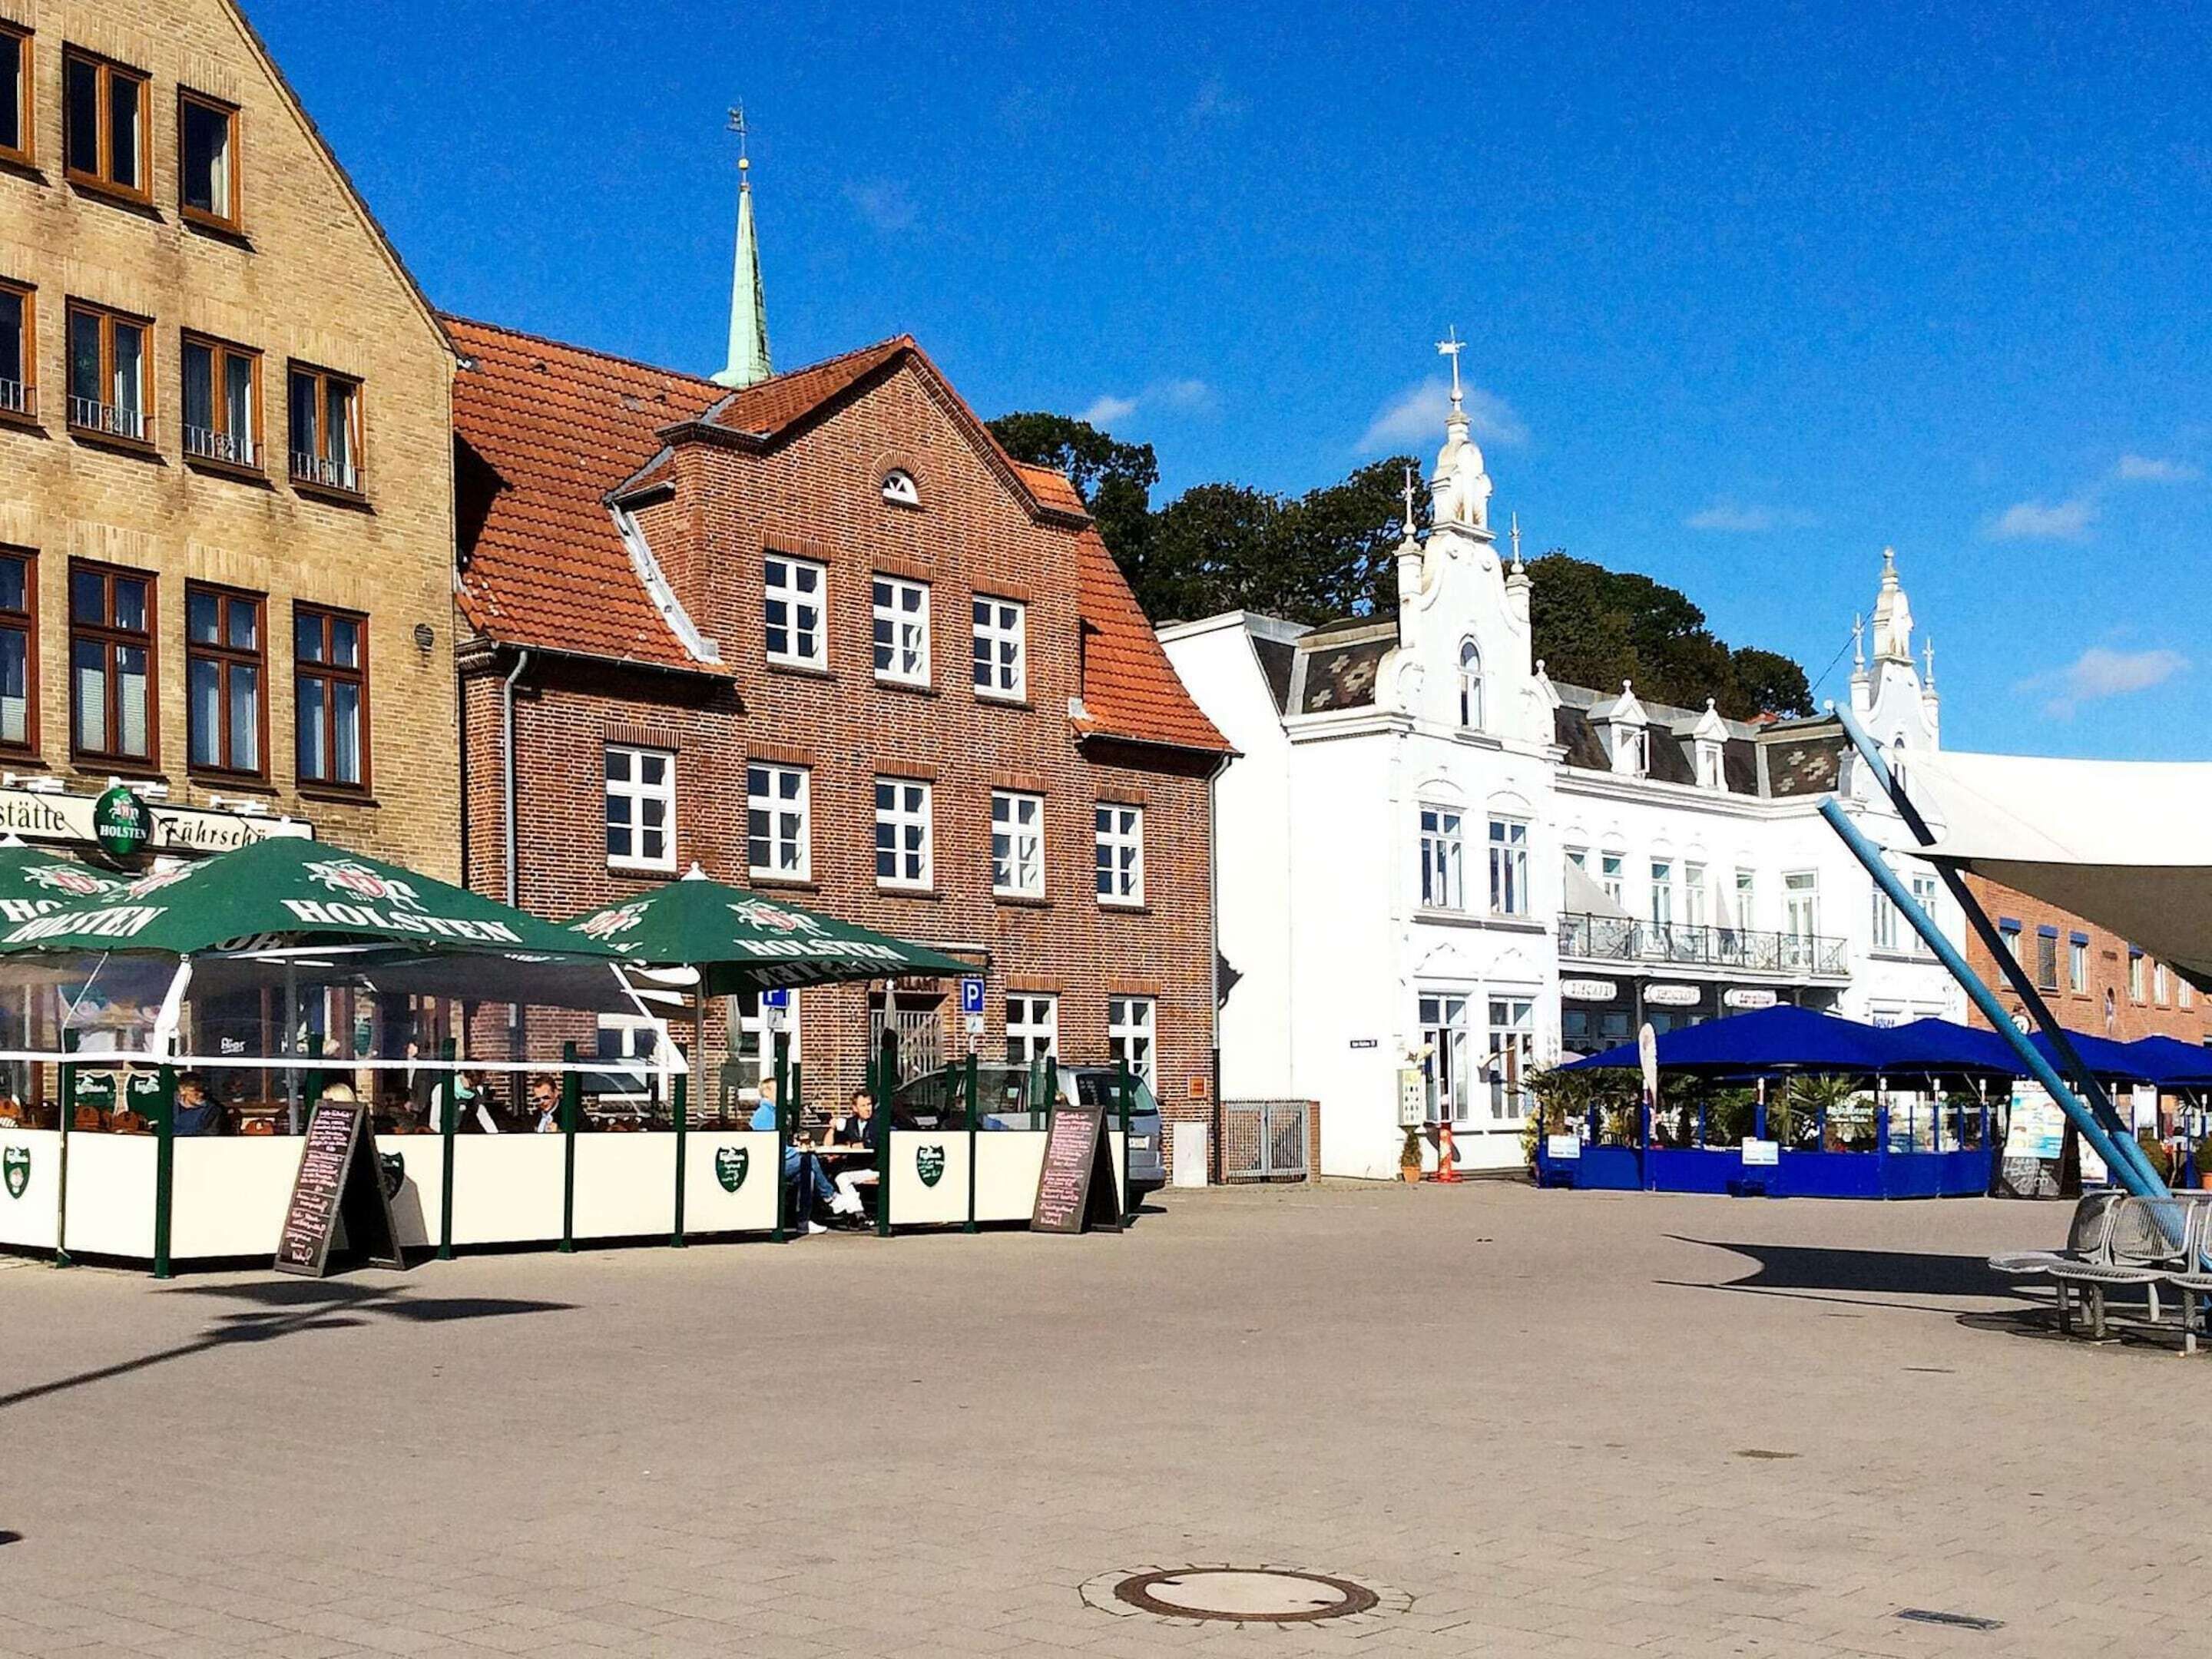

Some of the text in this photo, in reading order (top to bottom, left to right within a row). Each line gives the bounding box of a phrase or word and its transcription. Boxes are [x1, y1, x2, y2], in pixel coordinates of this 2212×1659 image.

[100, 824, 147, 839] HOLSTEN
[2, 906, 168, 943] HOLSTEN
[280, 899, 523, 943] HOLSTEN
[733, 939, 909, 961] HOLSTEN
[967, 984, 979, 1008] P
